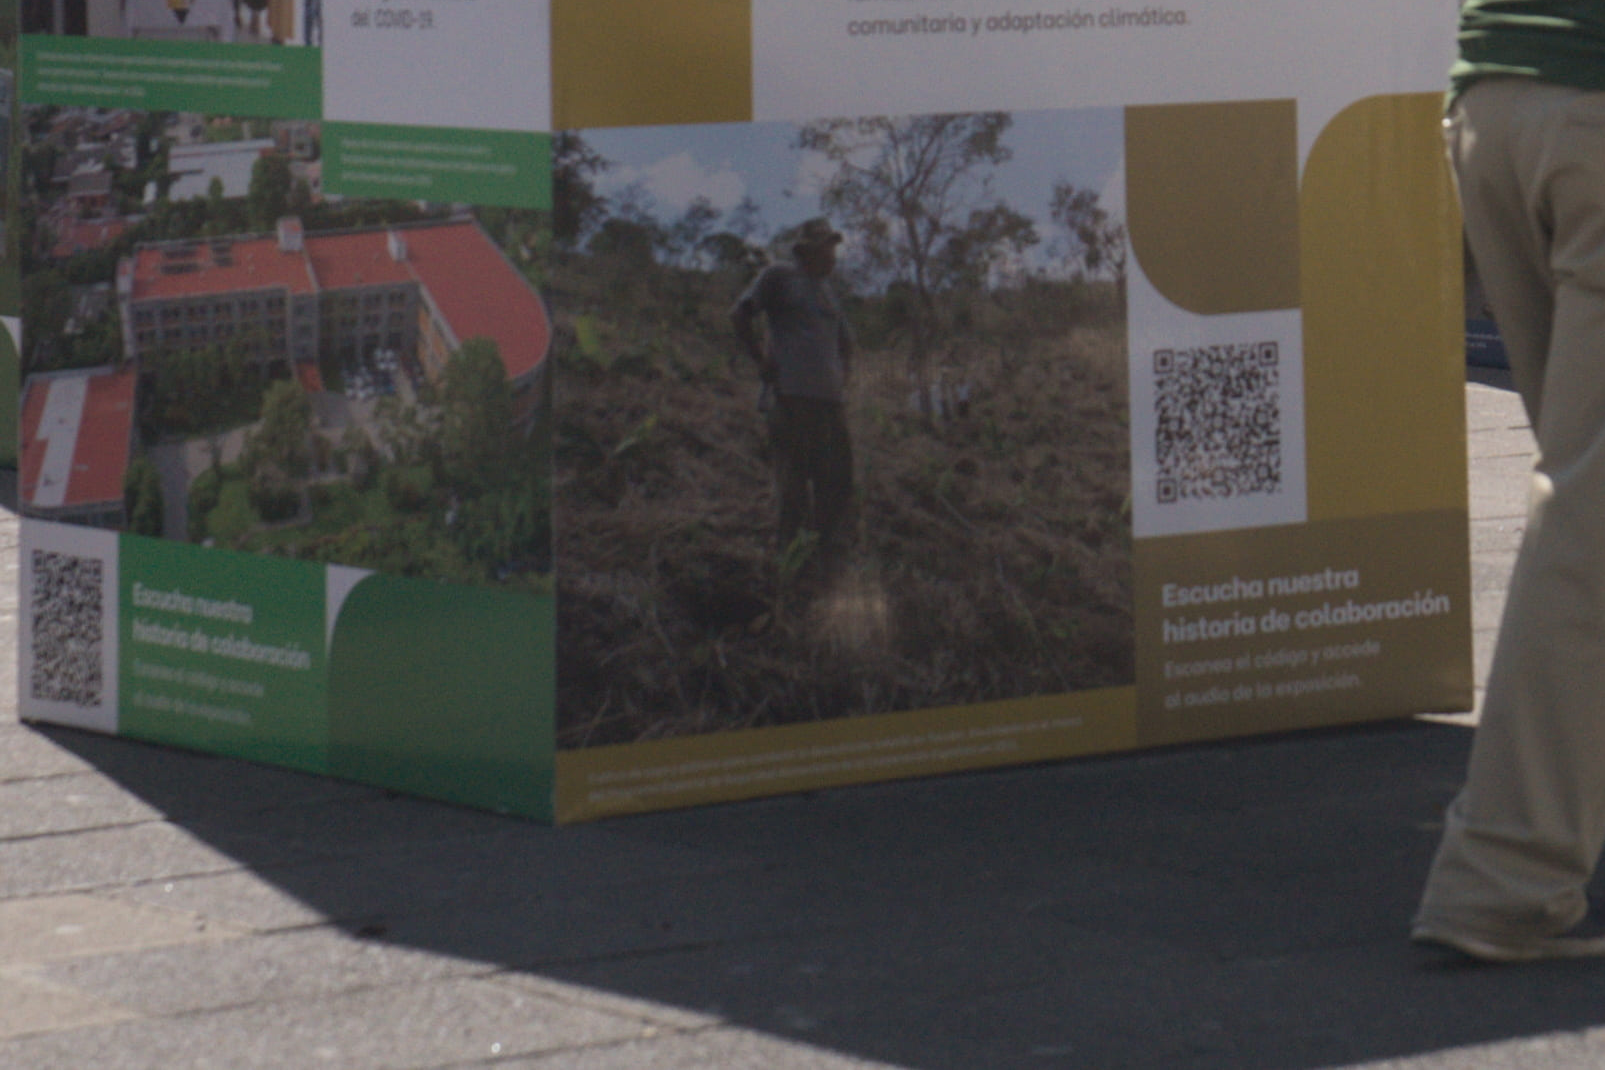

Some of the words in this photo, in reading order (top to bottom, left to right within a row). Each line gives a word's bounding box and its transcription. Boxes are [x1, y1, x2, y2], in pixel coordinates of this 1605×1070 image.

[849, 13, 967, 35] comunitaria
[970, 18, 981, 35] y
[985, 9, 1094, 33] adaptación
[1099, 7, 1189, 28] climática.
[1162, 576, 1263, 607] Escucha
[1268, 568, 1358, 596] nuestra
[1163, 612, 1255, 644] historia
[1260, 609, 1290, 632] de
[1294, 589, 1450, 629] colaboración
